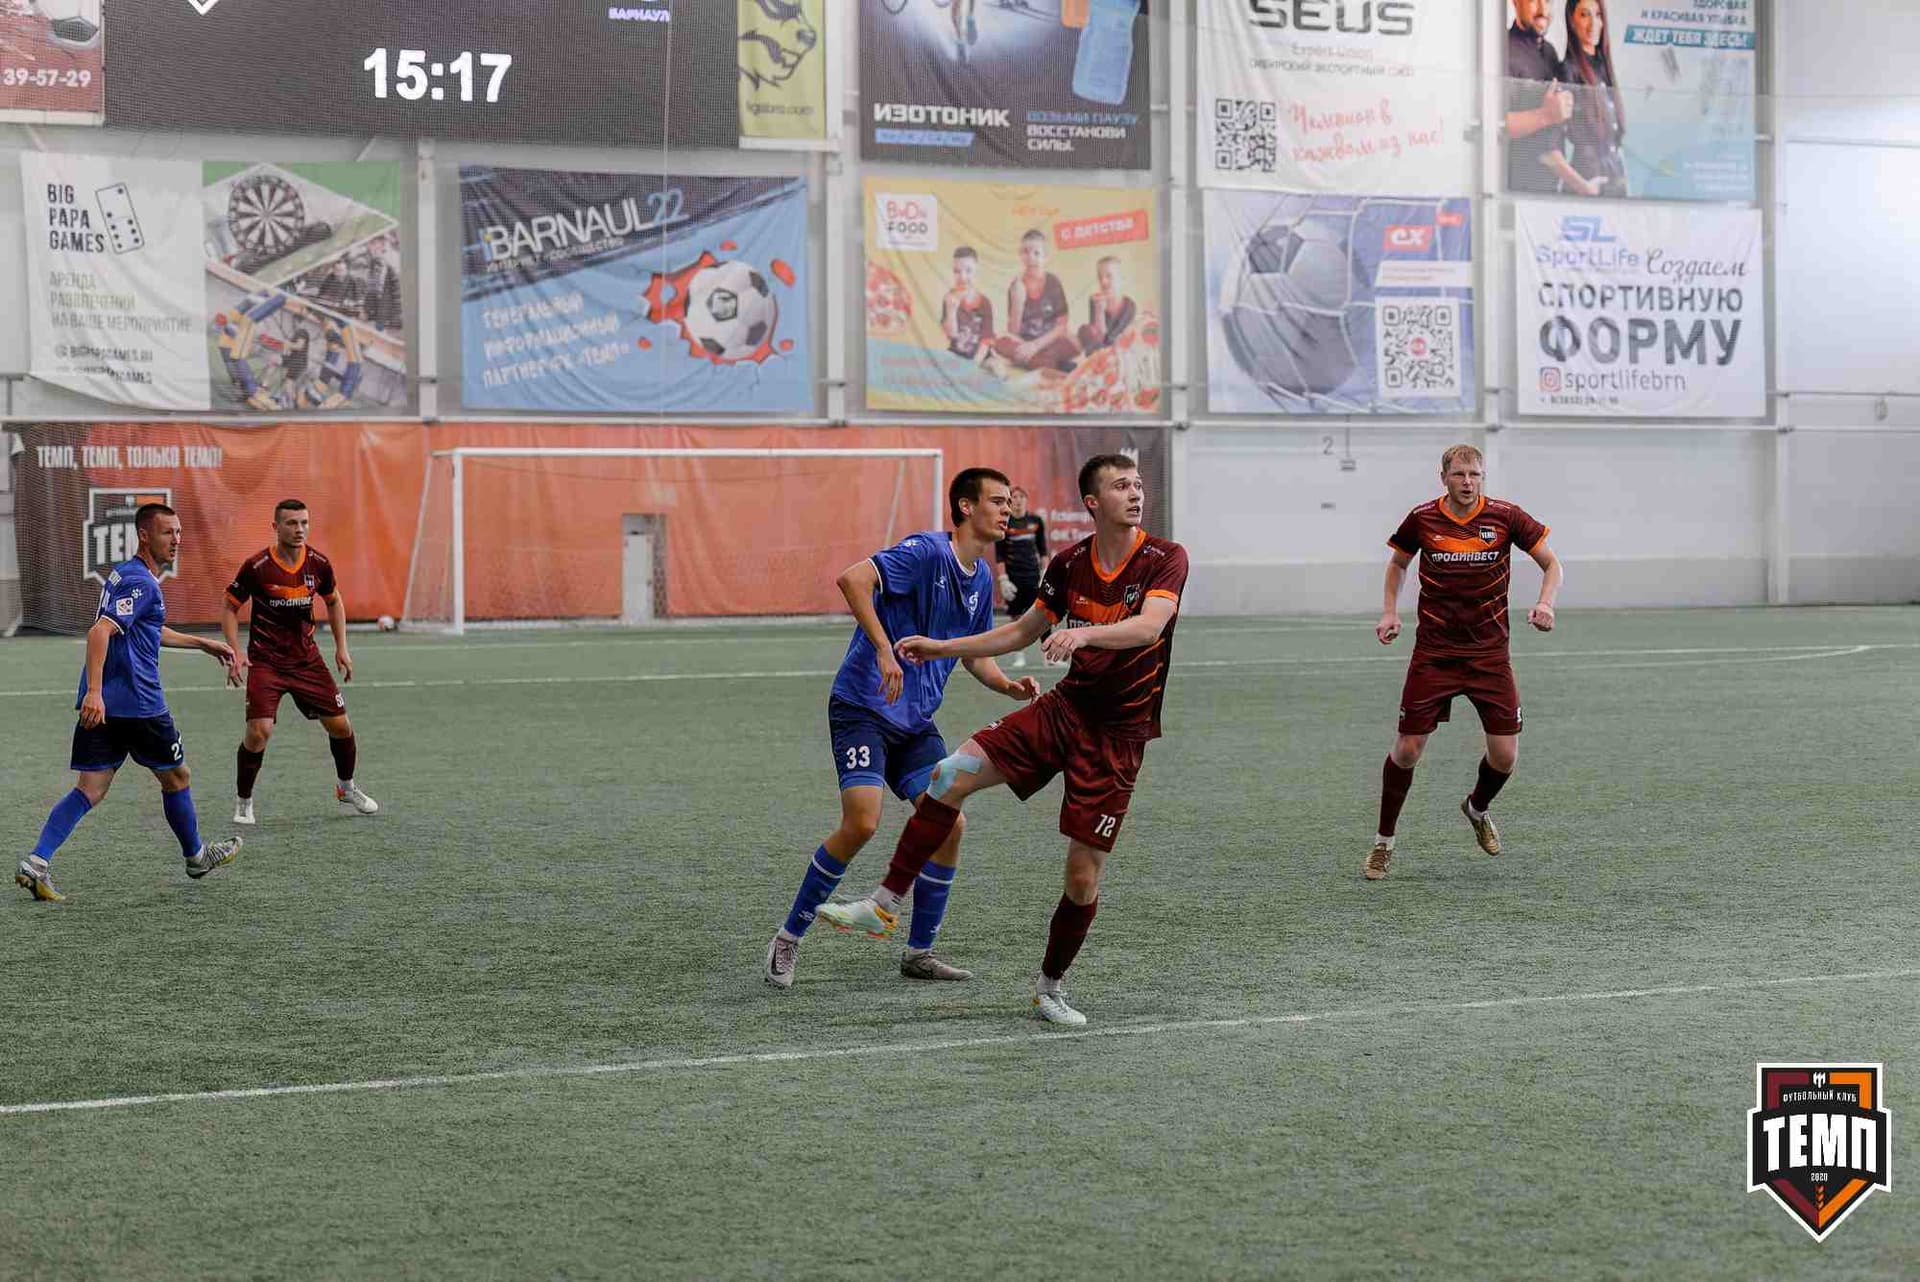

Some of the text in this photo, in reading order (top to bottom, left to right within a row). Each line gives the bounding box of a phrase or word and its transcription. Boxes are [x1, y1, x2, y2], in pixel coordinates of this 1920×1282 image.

[3, 68, 91, 87] 39-57-29
[364, 48, 512, 103] 15:17
[874, 103, 1011, 128] ИЗОТОНИК
[1027, 124, 1127, 139] ВОССТАНОВИ
[48, 184, 74, 204] BIG
[49, 207, 90, 229] PAPA
[887, 221, 928, 234] FOOD
[49, 230, 105, 253] GAMES
[1646, 247, 1747, 284] Создаем
[1538, 282, 1744, 313] СПОРТИВНУЮ
[1540, 315, 1743, 367] ФОРМУ
[1565, 368, 1687, 392] sportlifebrn
[37, 445, 223, 470] ТЕМП, ТЕМП, ТОЛЬКО ТЕМП!
[1322, 435, 1335, 456] 2
[1431, 551, 1500, 562] ПРОДИНВЕСТ
[846, 745, 871, 769] 33
[1094, 814, 1116, 838] 72
